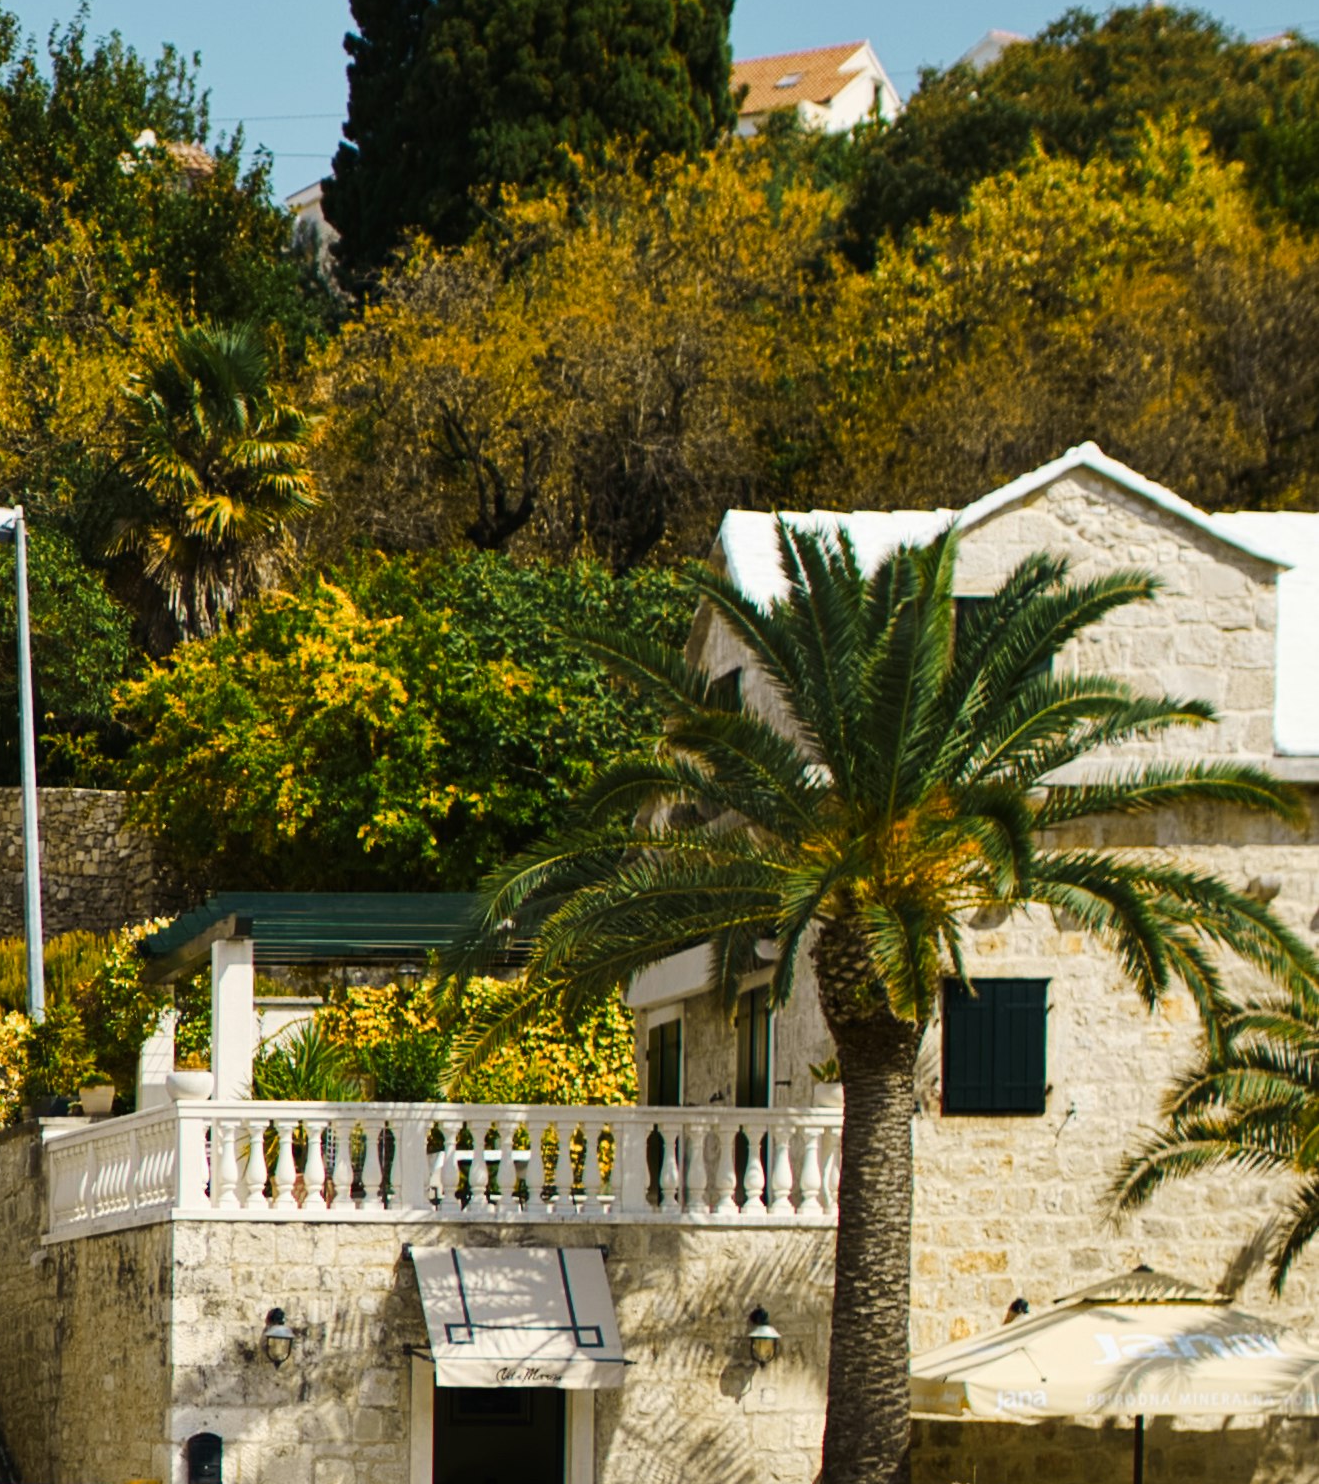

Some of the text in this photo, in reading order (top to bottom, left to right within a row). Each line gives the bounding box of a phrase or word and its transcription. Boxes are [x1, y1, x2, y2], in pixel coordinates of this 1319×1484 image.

[1093, 1332, 1285, 1365] jana
[995, 1387, 1048, 1412] jana
[1178, 1392, 1274, 1407] MINERALNA
